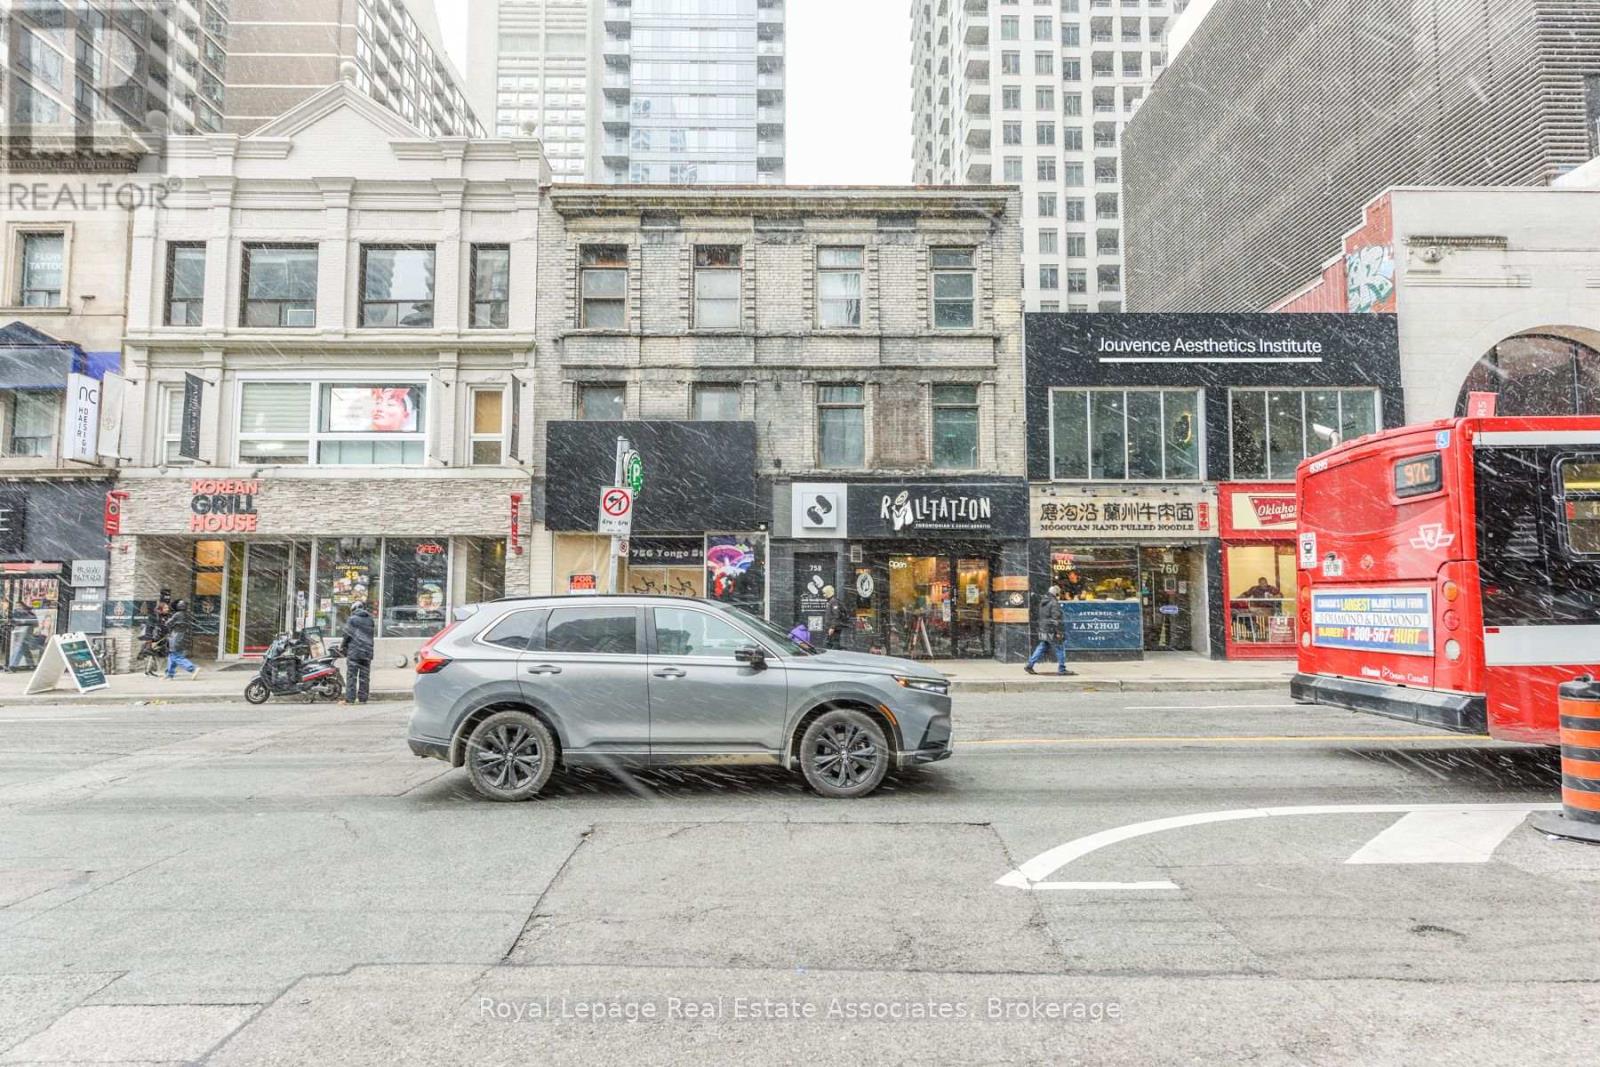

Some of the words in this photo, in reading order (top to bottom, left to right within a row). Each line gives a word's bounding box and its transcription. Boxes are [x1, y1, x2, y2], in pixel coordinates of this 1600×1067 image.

[1099, 338, 1170, 353] Jouvence
[1174, 338, 1256, 353] Aesthetics
[1259, 338, 1322, 354] Institute
[191, 480, 259, 495] KOREAN
[190, 494, 258, 514] GRILL
[1257, 502, 1297, 516] Oklaho
[190, 513, 258, 532] HOUSE
[416, 544, 443, 554] OPEN
[657, 549, 689, 559] Yonge
[1160, 564, 1179, 574] 760
[574, 575, 593, 583] FOR
[1072, 622, 1120, 630] LANZHOU
[1326, 614, 1362, 625] DIAMOND
[1373, 614, 1421, 626] DIAMOND
